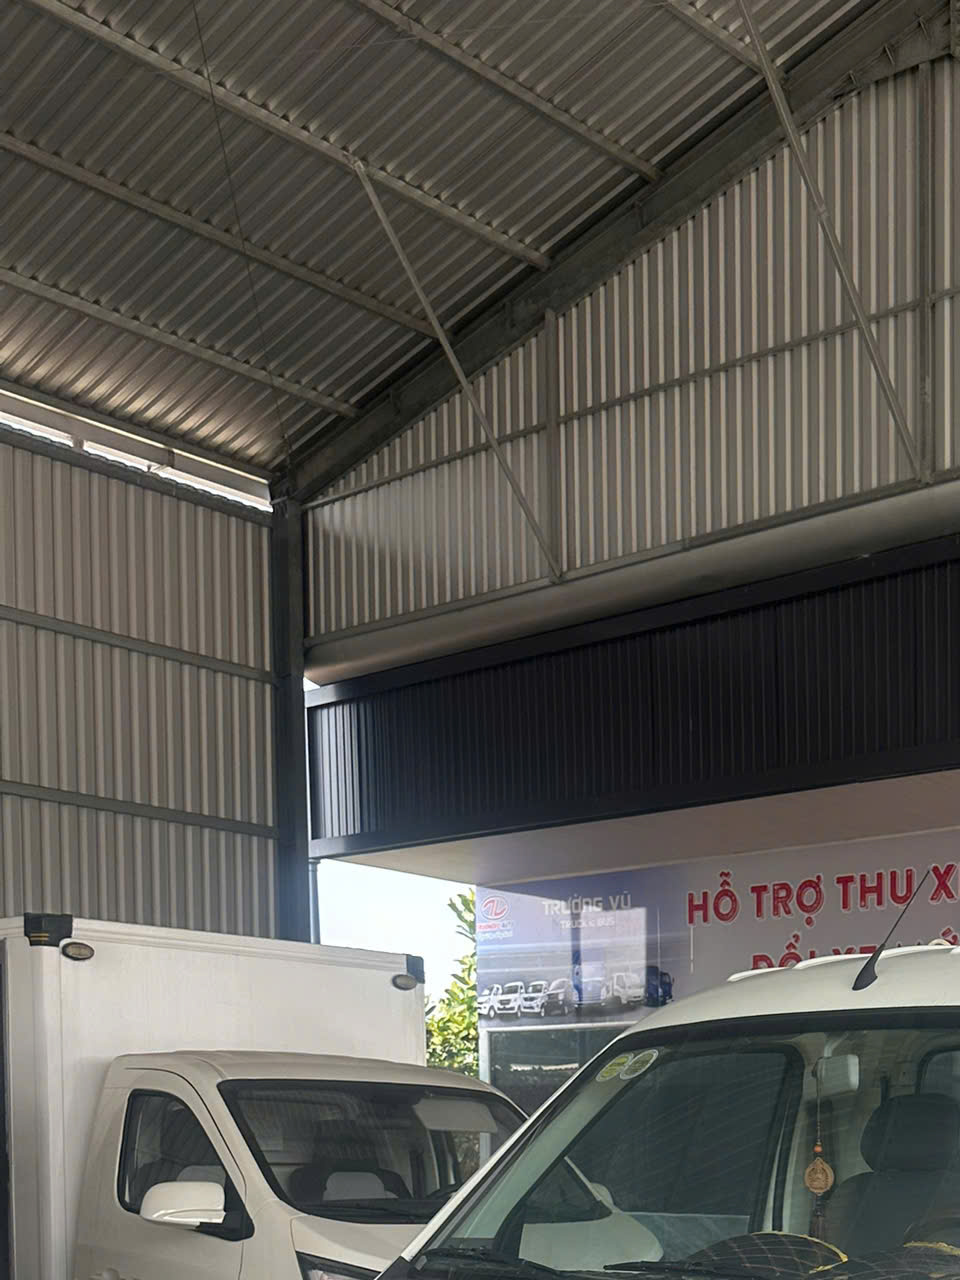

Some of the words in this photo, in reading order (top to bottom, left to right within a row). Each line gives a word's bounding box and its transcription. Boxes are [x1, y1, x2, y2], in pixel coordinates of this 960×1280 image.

[687, 870, 739, 926] HỖ
[750, 874, 824, 928] TRỢ
[835, 867, 914, 911] THU
